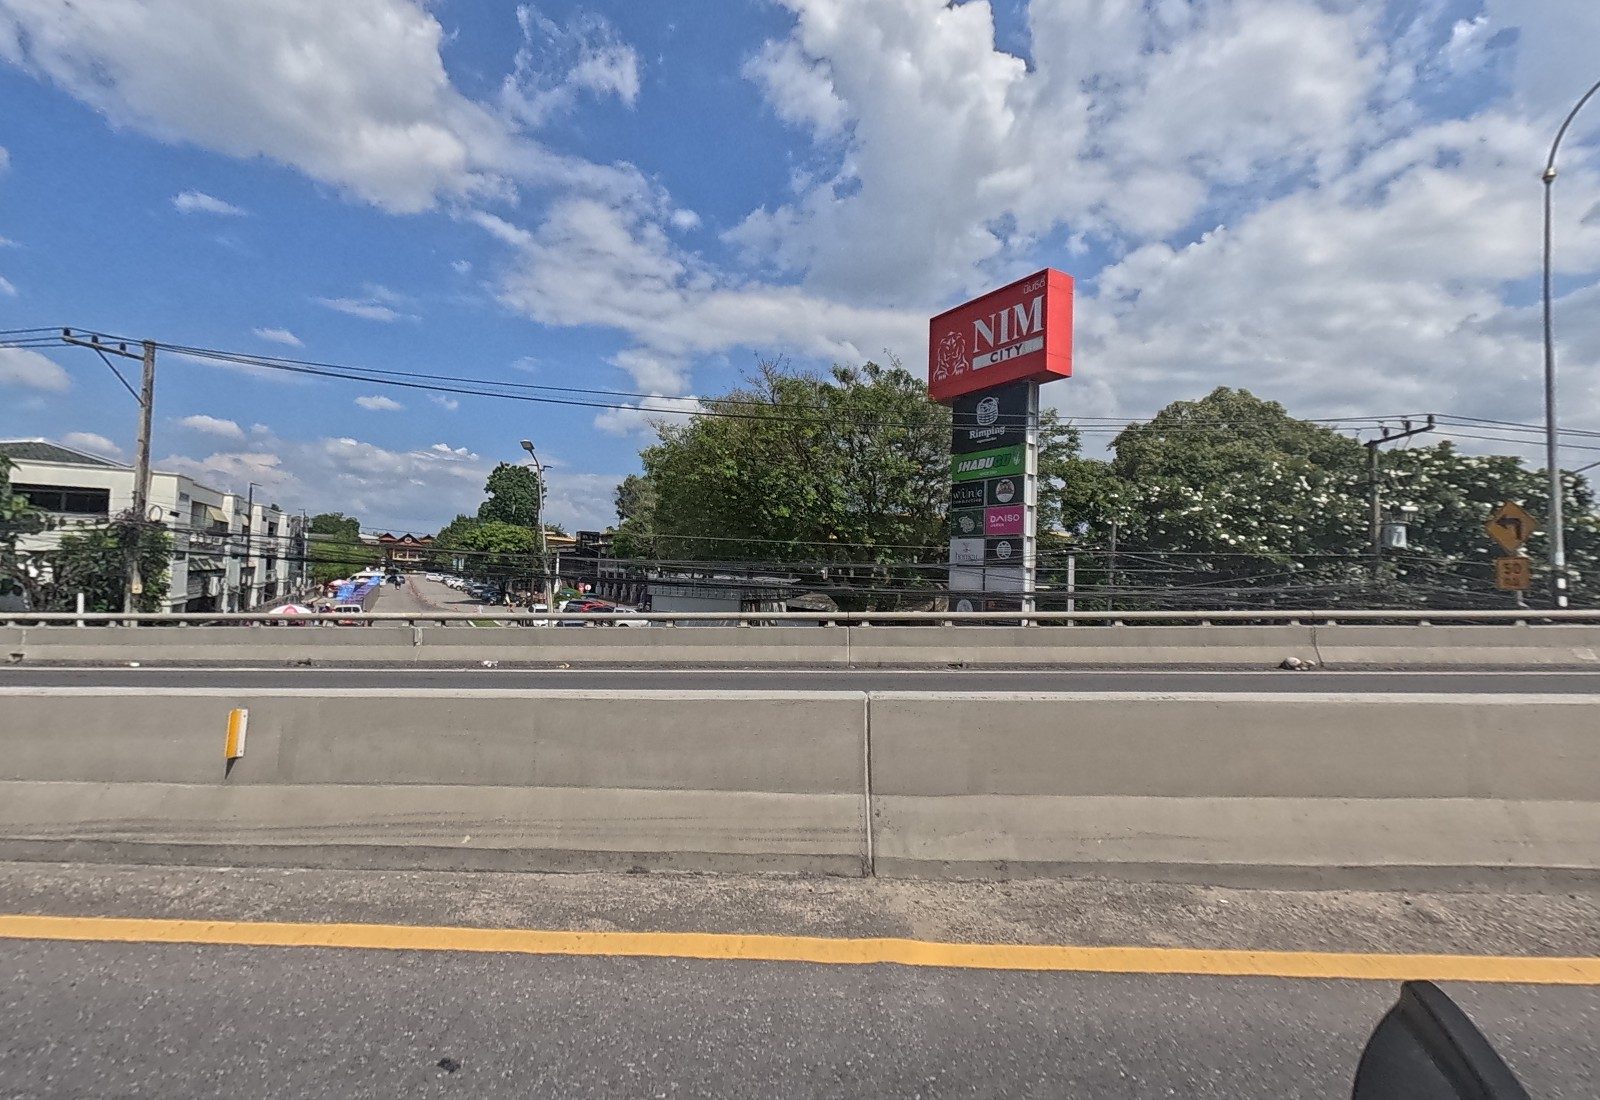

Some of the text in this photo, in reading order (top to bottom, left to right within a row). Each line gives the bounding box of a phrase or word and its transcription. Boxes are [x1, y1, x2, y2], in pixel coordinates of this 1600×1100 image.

[973, 295, 1044, 353] NIM
[990, 344, 1023, 363] CITY
[969, 426, 1006, 440] Rimping
[990, 513, 1020, 523] DAISO
